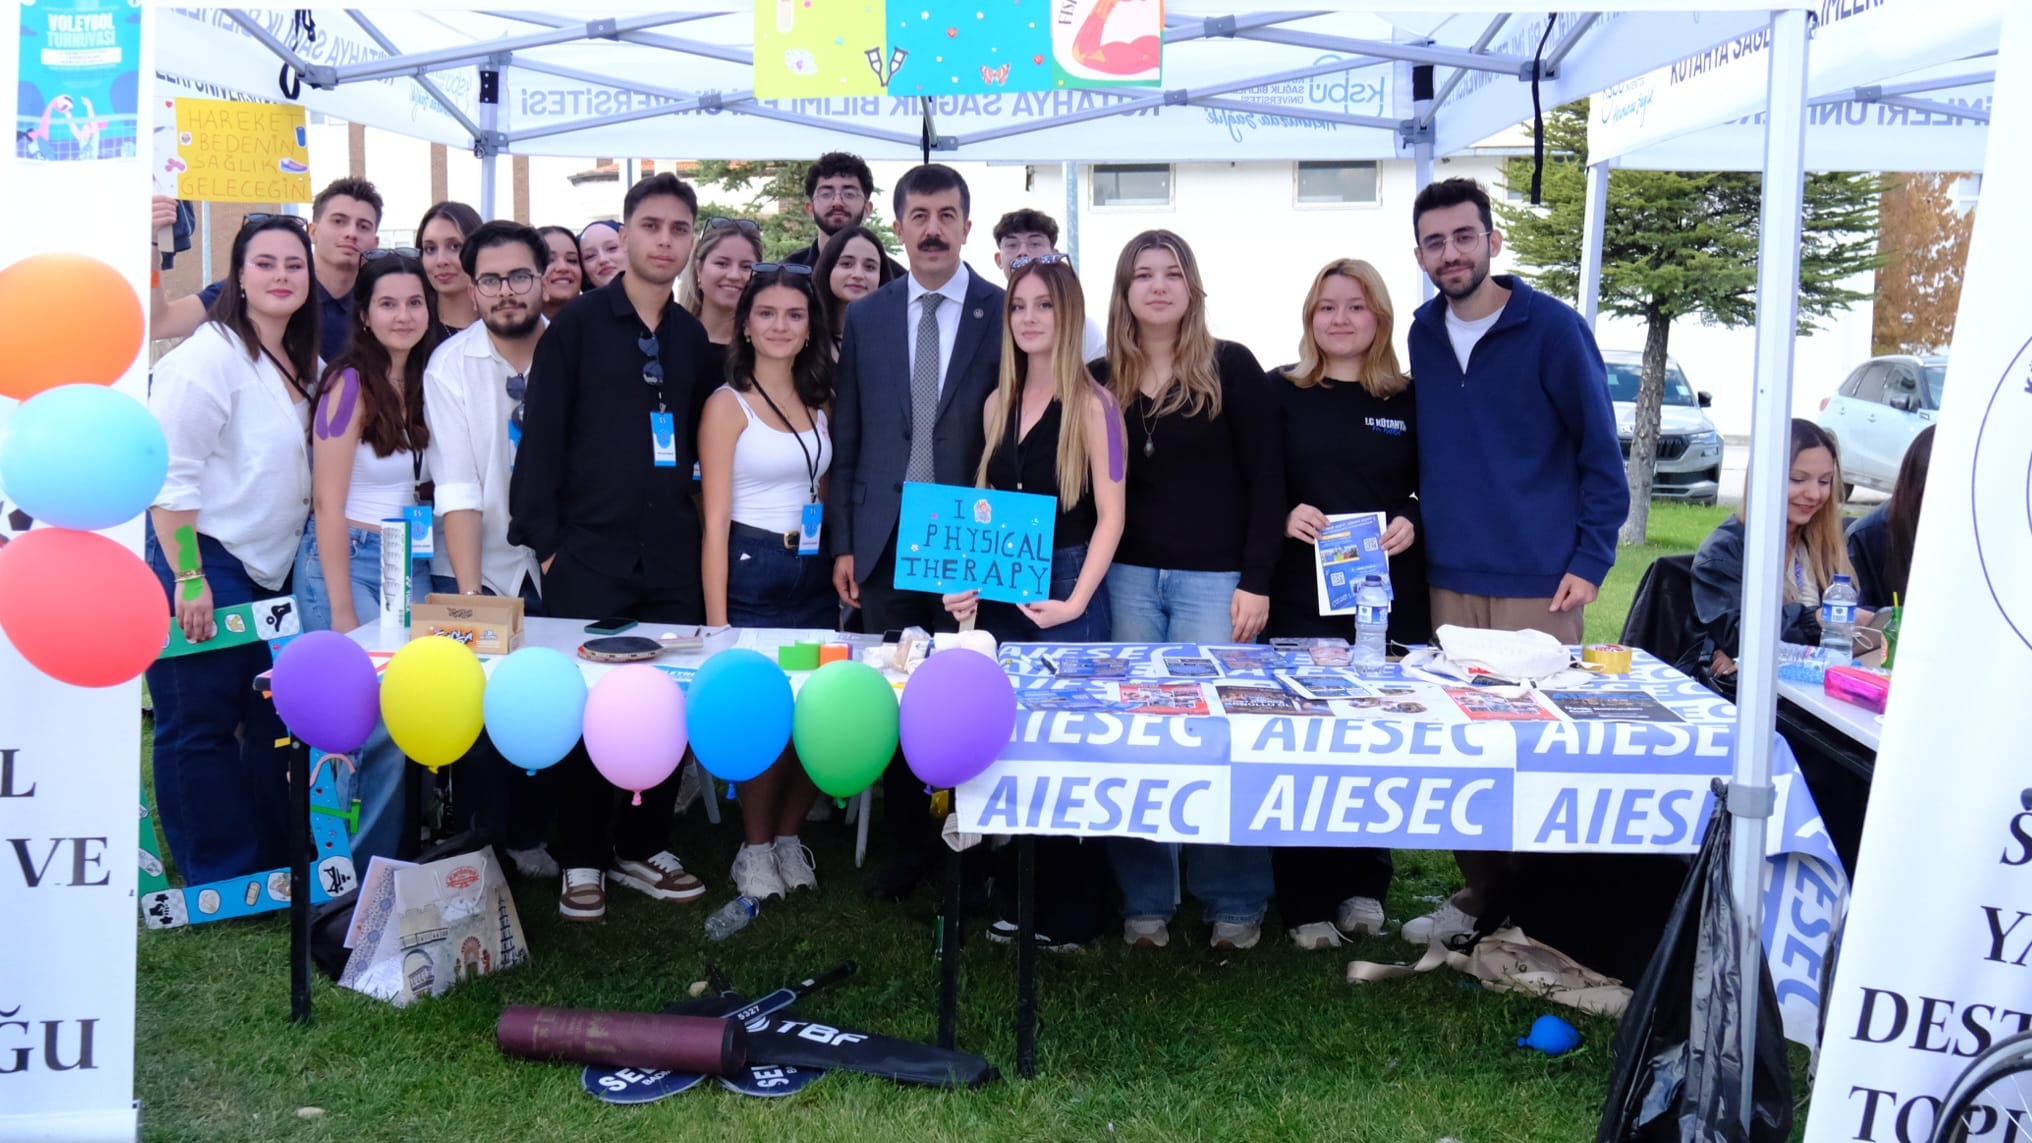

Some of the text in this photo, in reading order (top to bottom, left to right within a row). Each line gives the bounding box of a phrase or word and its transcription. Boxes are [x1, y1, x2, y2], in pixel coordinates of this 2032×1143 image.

[48, 13, 115, 32] VOLEYBOL
[188, 110, 304, 132] HAREKET
[199, 133, 296, 156] BEDENİN
[953, 499, 966, 519] I
[923, 523, 1051, 563] PHYSICAL
[902, 556, 1049, 595] THERAPY
[1251, 716, 1485, 756] AIESEC
[1533, 721, 1730, 758] AIESE
[977, 775, 1212, 836] AIESEC
[1248, 775, 1496, 837] AIESEC
[1534, 788, 1710, 846] AIES
[6, 836, 112, 889] VE
[737, 1005, 761, 1021] 5327
[776, 1020, 869, 1047] TBF
